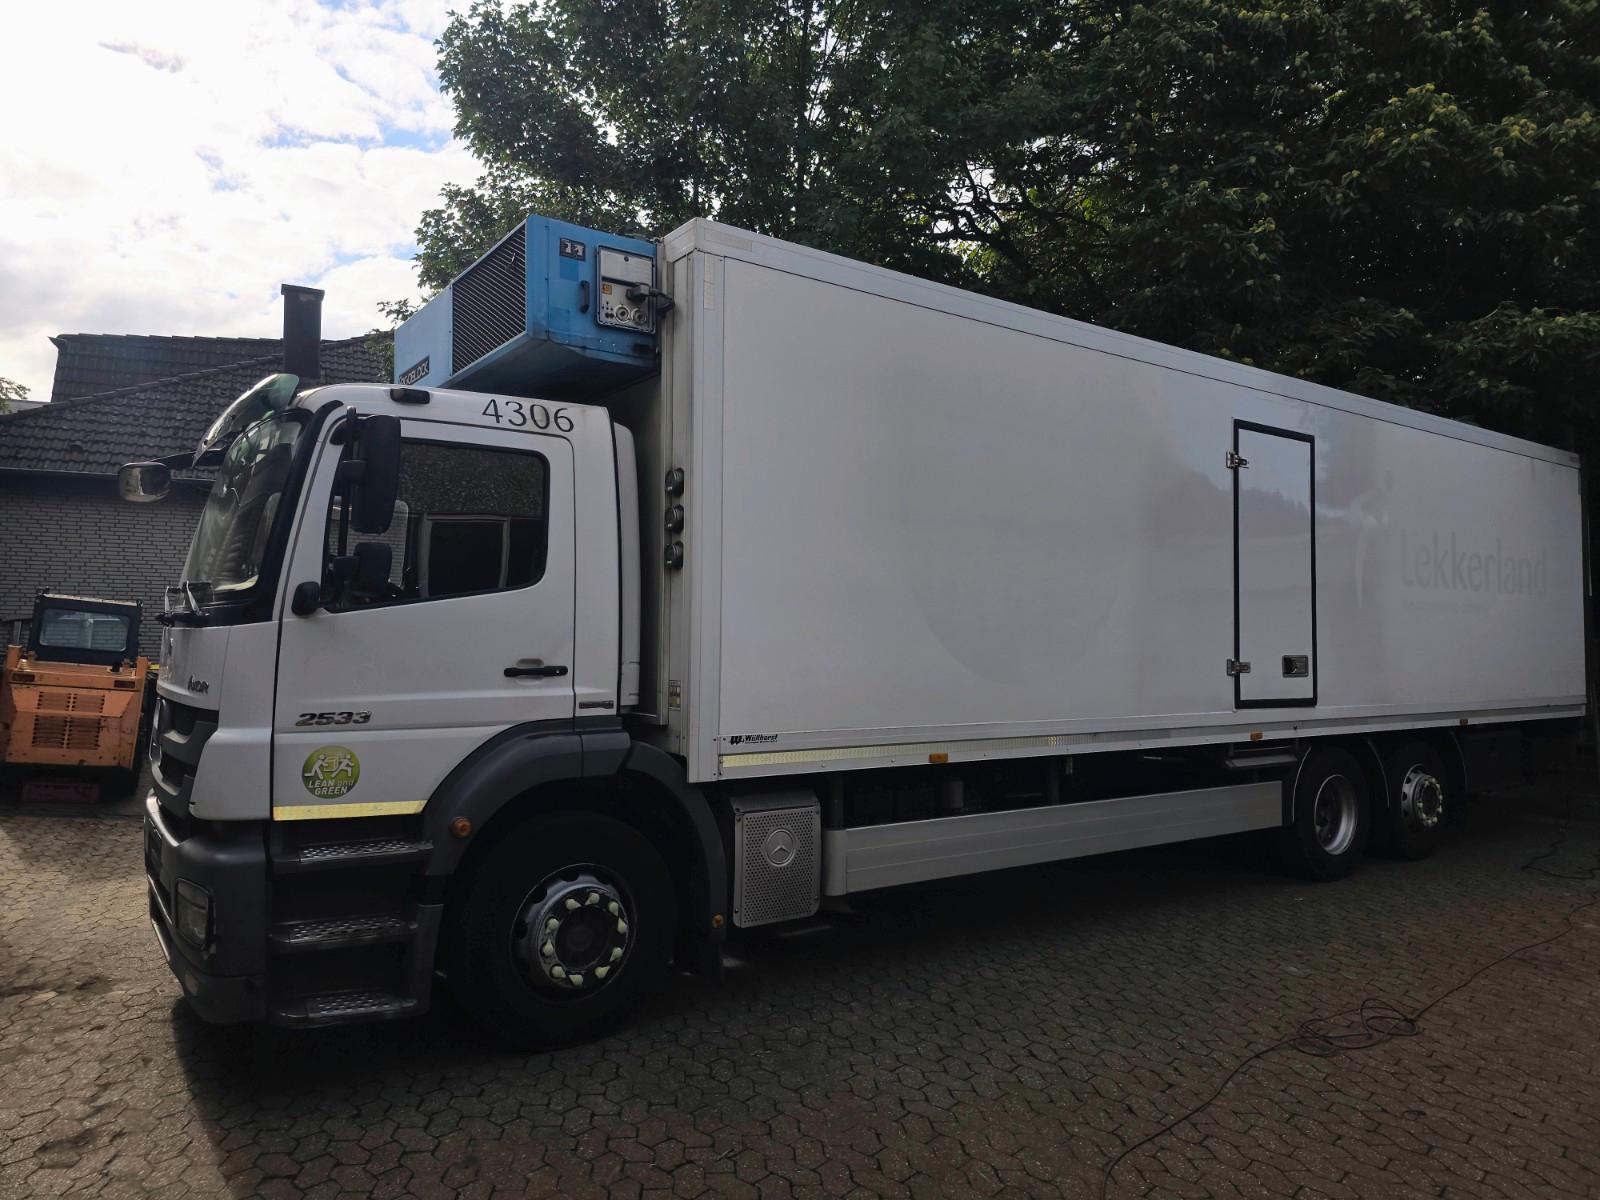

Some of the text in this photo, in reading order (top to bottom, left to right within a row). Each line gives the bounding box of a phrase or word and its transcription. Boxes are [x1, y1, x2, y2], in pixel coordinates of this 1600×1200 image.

[482, 398, 575, 433] 4306
[1401, 528, 1549, 597] Lekkerland
[296, 711, 372, 727] 2533
[308, 779, 335, 789] LEAN
[314, 786, 348, 796] GREEN
